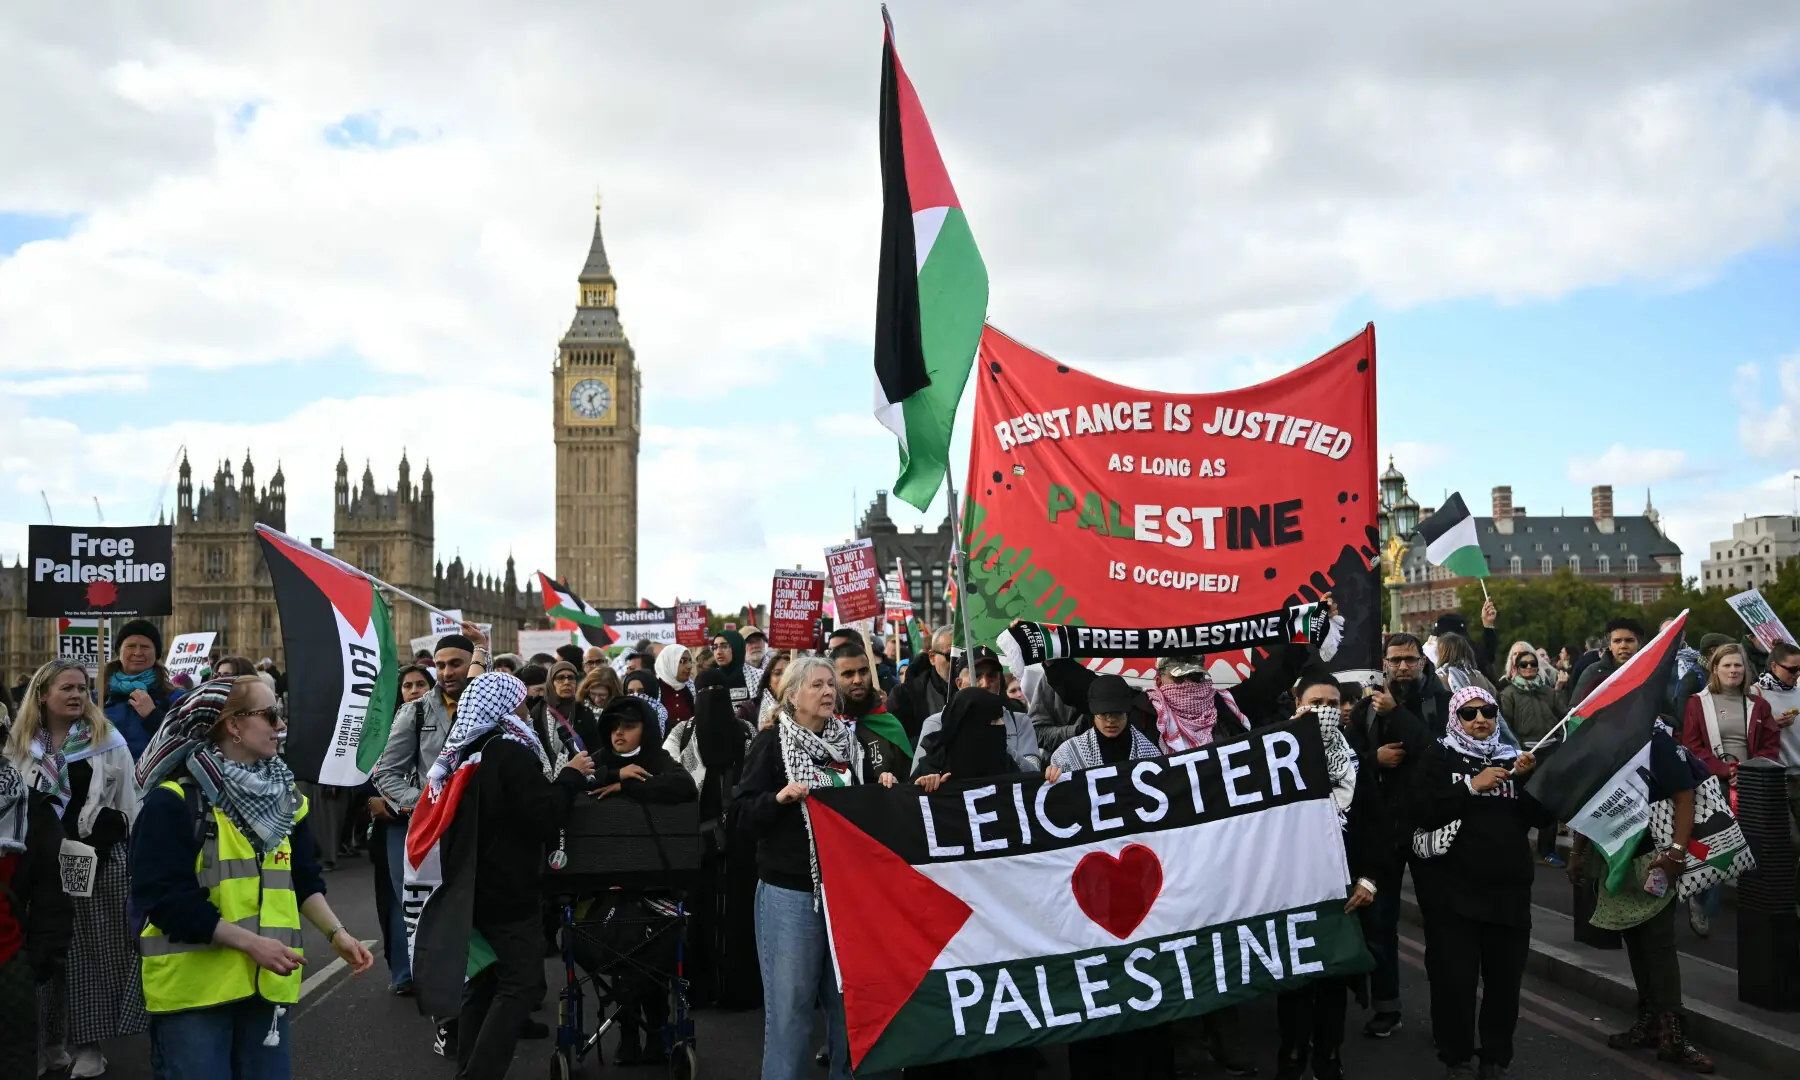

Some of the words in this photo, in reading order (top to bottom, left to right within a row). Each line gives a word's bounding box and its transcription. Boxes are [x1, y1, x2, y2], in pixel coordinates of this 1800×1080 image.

[994, 401, 1153, 451] RESISTANCE
[1163, 402, 1192, 432] IS
[1203, 406, 1353, 460] JUSTIFIED
[1108, 453, 1134, 472] AS
[1141, 455, 1191, 477] LONG
[1199, 458, 1226, 477] AS
[1047, 483, 1303, 550] PALESTINE
[70, 532, 135, 557] Free
[829, 555, 843, 566] IT'S
[844, 551, 859, 563] NOT
[859, 550, 865, 559] A
[35, 557, 166, 583] Palestine
[832, 563, 854, 575] CRIME
[855, 560, 865, 570] TO
[776, 578, 791, 588] IT'S
[792, 579, 807, 590] NOT
[807, 580, 813, 590] A
[834, 575, 847, 586] ACT
[848, 568, 875, 582] AGAINST
[1109, 560, 1127, 580] IS
[1133, 564, 1240, 593] OCCUPIED!
[775, 588, 799, 599] CRIME
[800, 590, 810, 599] TO
[835, 579, 870, 596] GENOCIDE
[774, 599, 789, 609] ACT
[790, 600, 819, 611] AGAINST
[615, 610, 665, 621] Sheffield
[774, 609, 809, 620] GENOCIDE
[1310, 617, 1319, 631] FREE
[626, 630, 660, 640] Palestine
[1020, 624, 1039, 658] PALESTINE
[1033, 631, 1044, 648] FREE
[1077, 626, 1141, 649] FREE
[1147, 617, 1280, 648] PALESTINE
[60, 636, 109, 654] FREE
[60, 654, 109, 663] PALESTIE
[170, 655, 203, 665] Arming
[918, 730, 1307, 857] LEICESTER
[65, 874, 87, 882] ESTINE
[945, 910, 1325, 1036] PALESTINE
